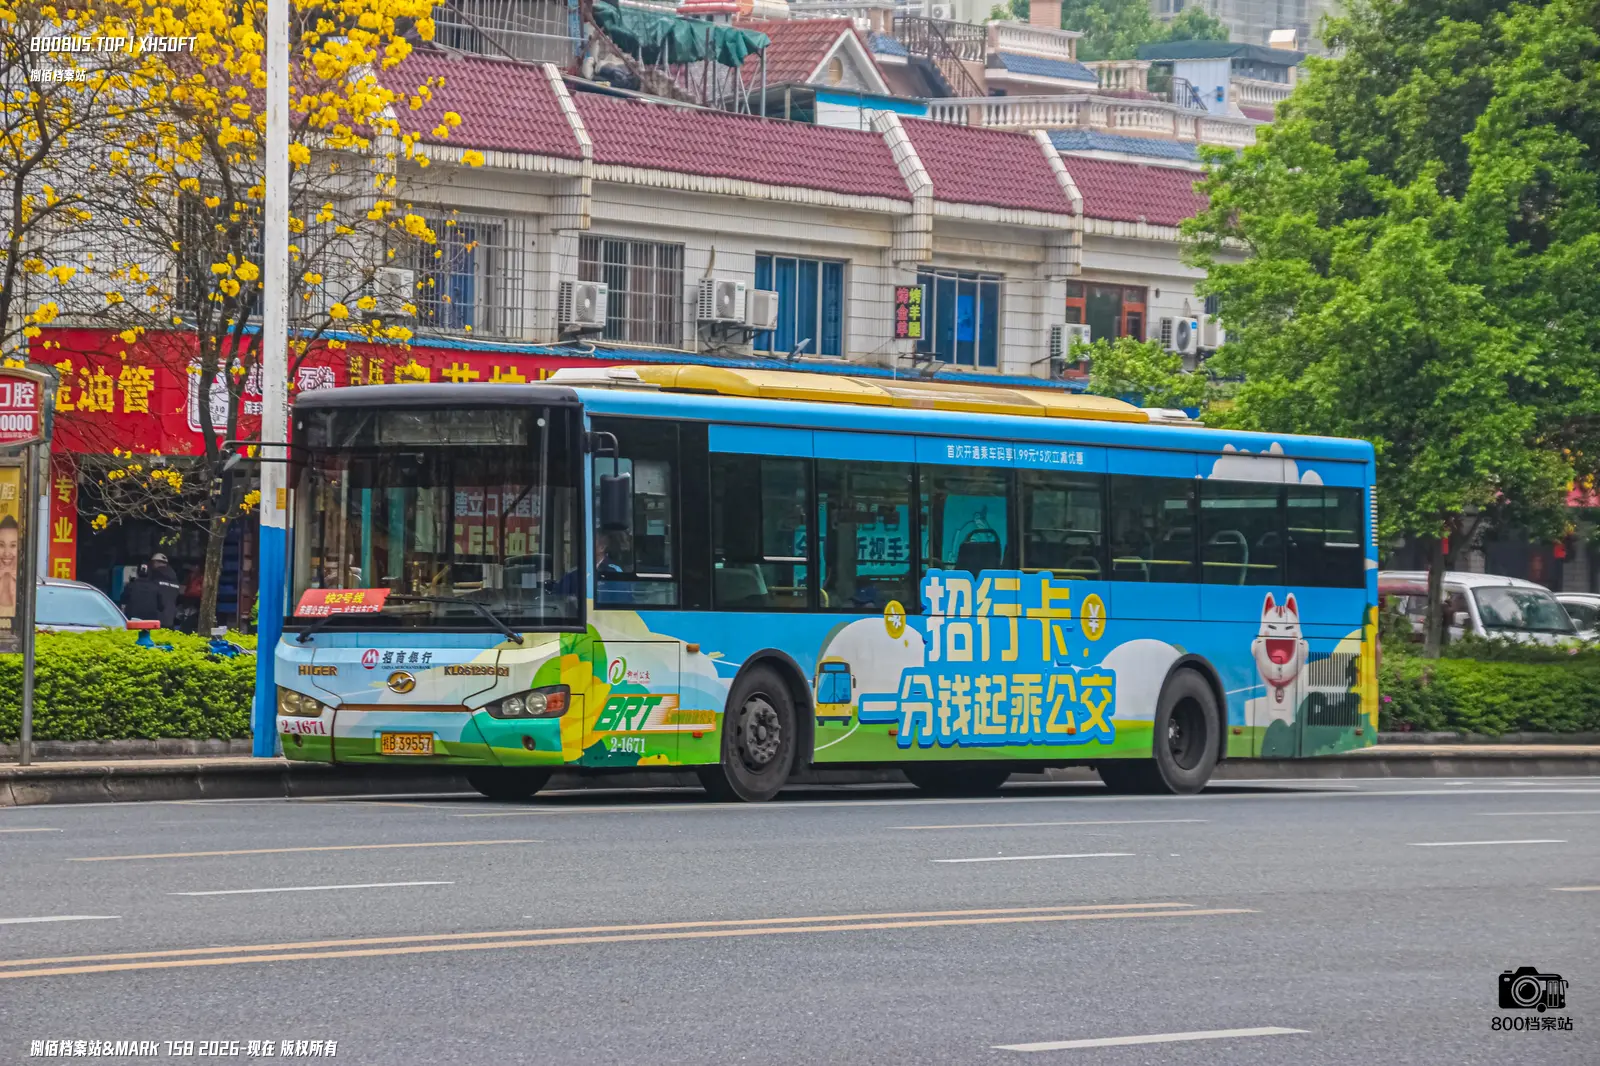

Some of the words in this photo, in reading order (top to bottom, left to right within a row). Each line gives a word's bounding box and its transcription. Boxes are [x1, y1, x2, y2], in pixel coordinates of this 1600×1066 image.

[925, 576, 1072, 662] 招行卡
[382, 651, 432, 663] 招商银行
[298, 665, 337, 676] HIGER
[863, 673, 1112, 736] 一分钱起乘公交
[593, 696, 663, 731] BRT
[282, 720, 326, 735] 2-1671
[610, 737, 645, 753] 2-1671
